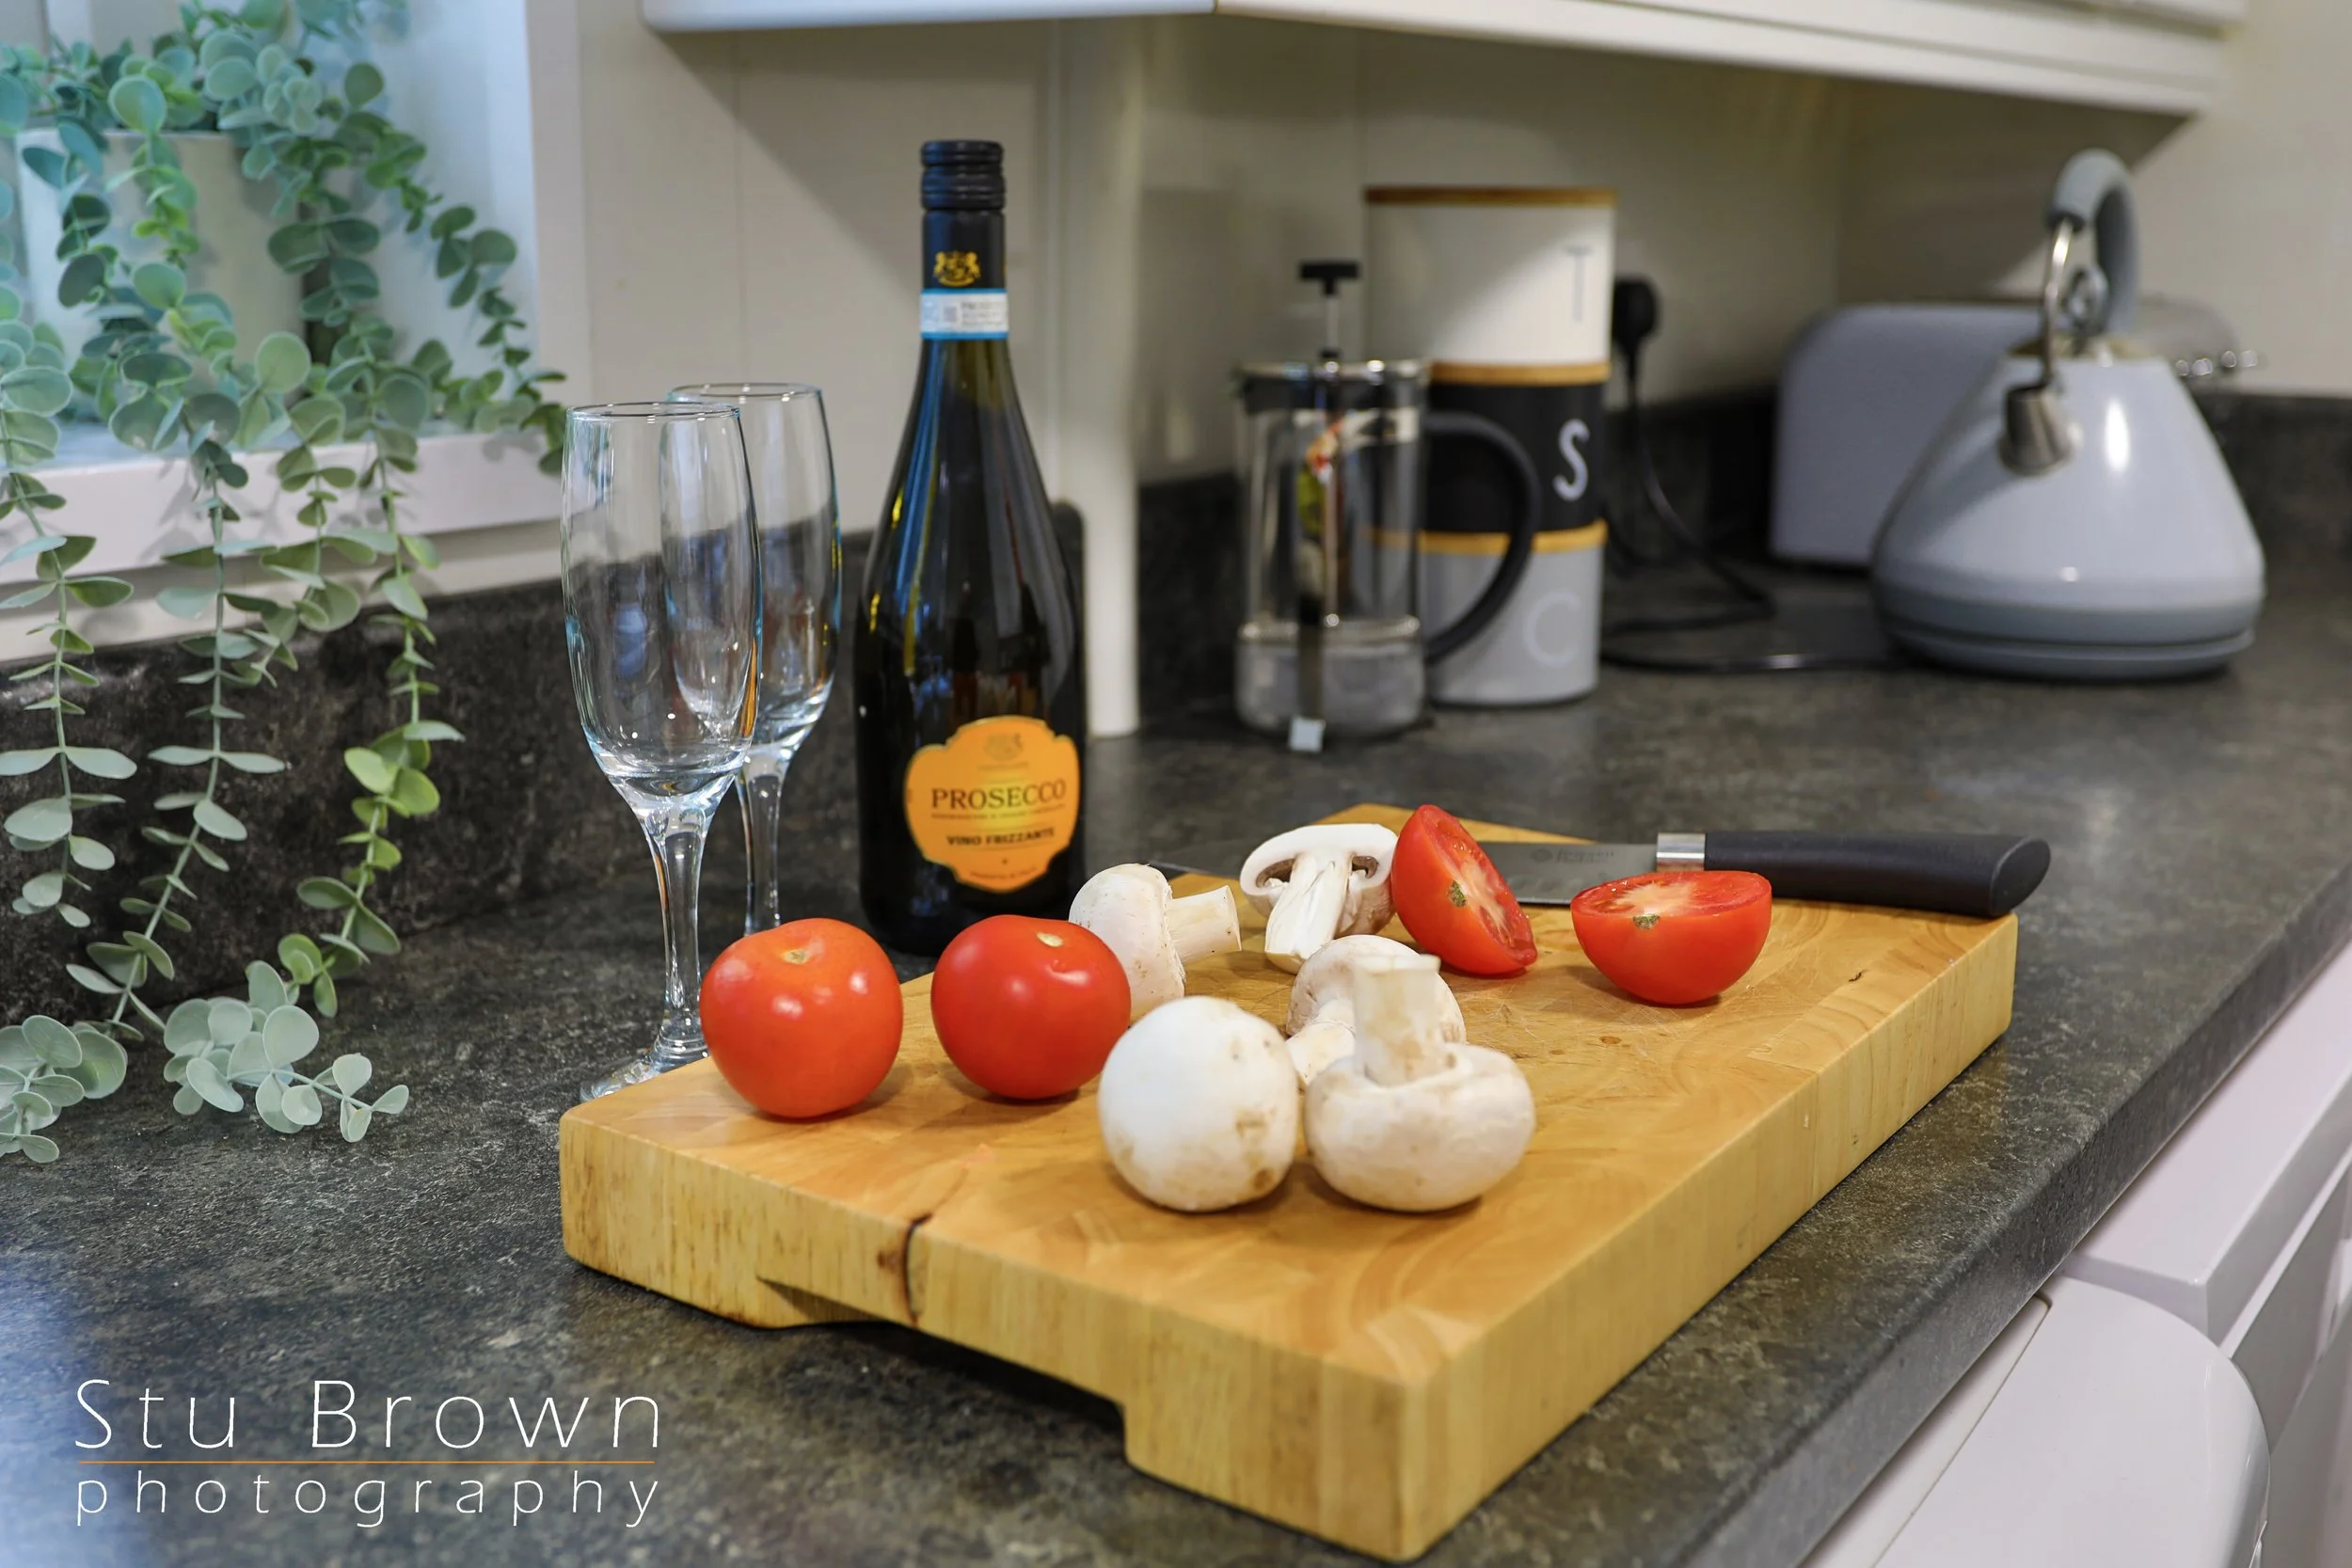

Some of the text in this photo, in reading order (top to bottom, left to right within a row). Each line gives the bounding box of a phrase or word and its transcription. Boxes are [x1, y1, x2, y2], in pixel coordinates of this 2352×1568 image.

[1565, 245, 1593, 322] T
[1553, 419, 1591, 501] S
[1523, 591, 1581, 669] C
[931, 778, 1067, 811] PROSECCO
[946, 834, 982, 847] VINO
